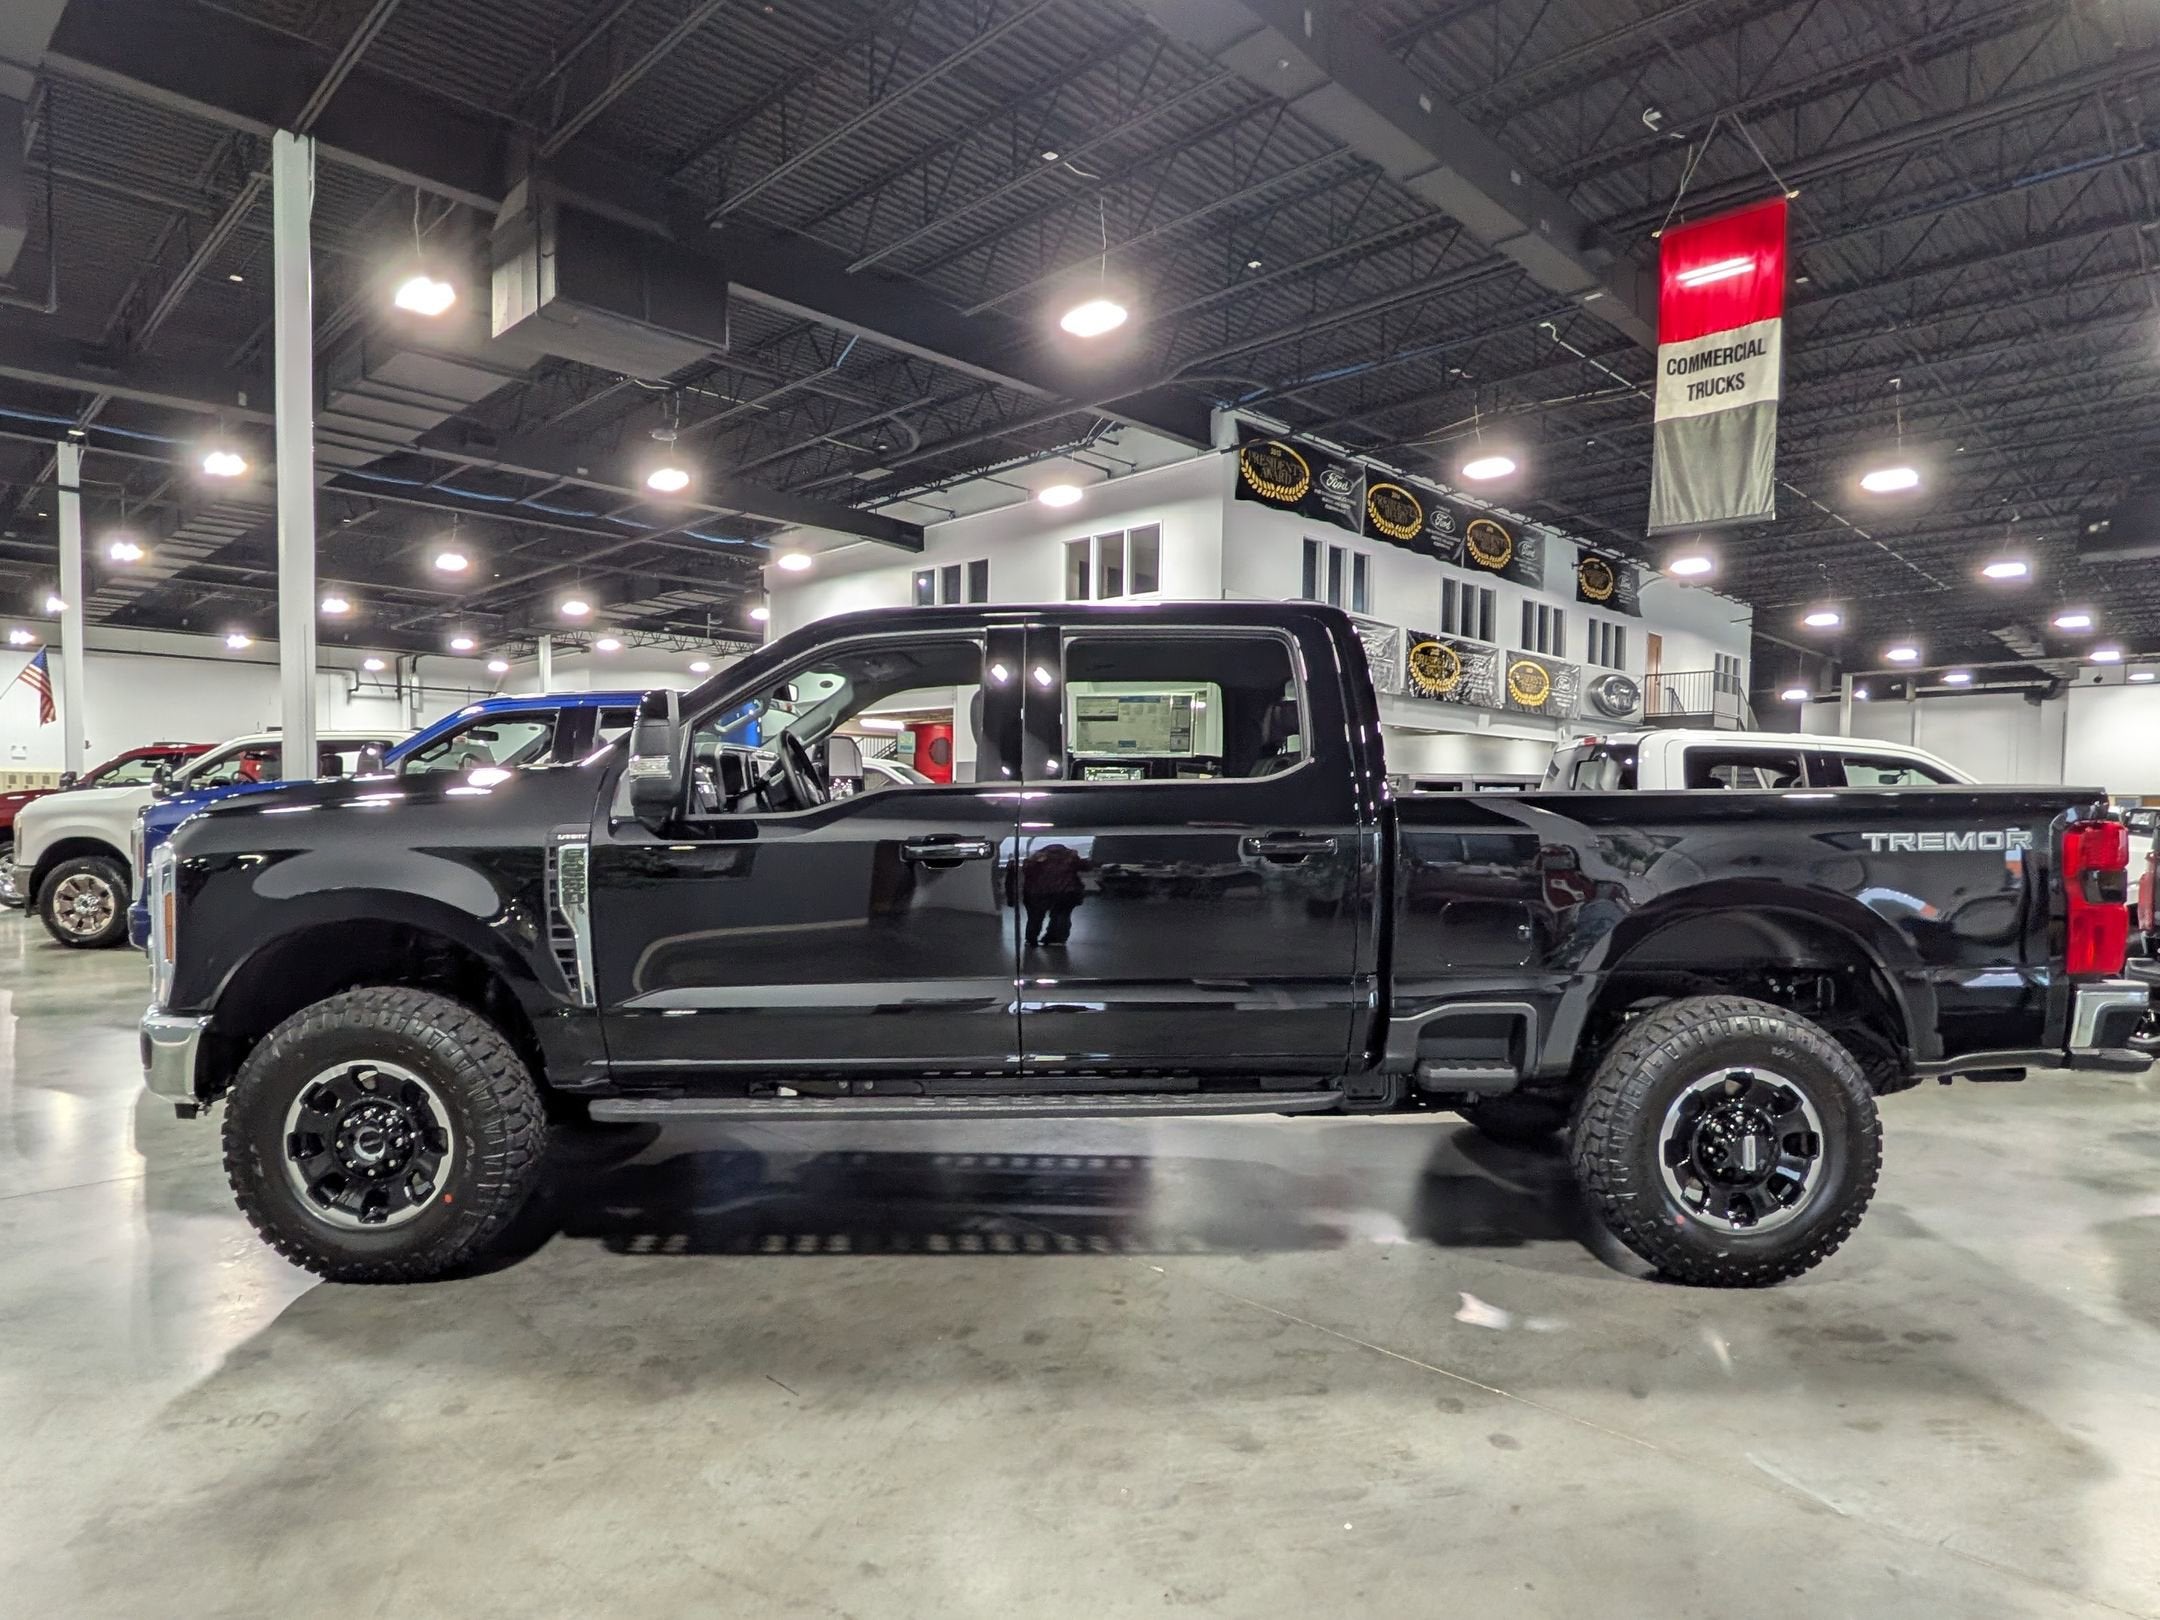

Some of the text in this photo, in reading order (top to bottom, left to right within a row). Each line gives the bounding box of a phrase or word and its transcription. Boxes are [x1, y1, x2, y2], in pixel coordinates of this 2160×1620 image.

[1666, 338, 1767, 376] COMMERCIAL
[1686, 372, 1745, 402] TRUCKS
[1326, 472, 1350, 491] Ford
[1861, 831, 2034, 852] TREMOR
